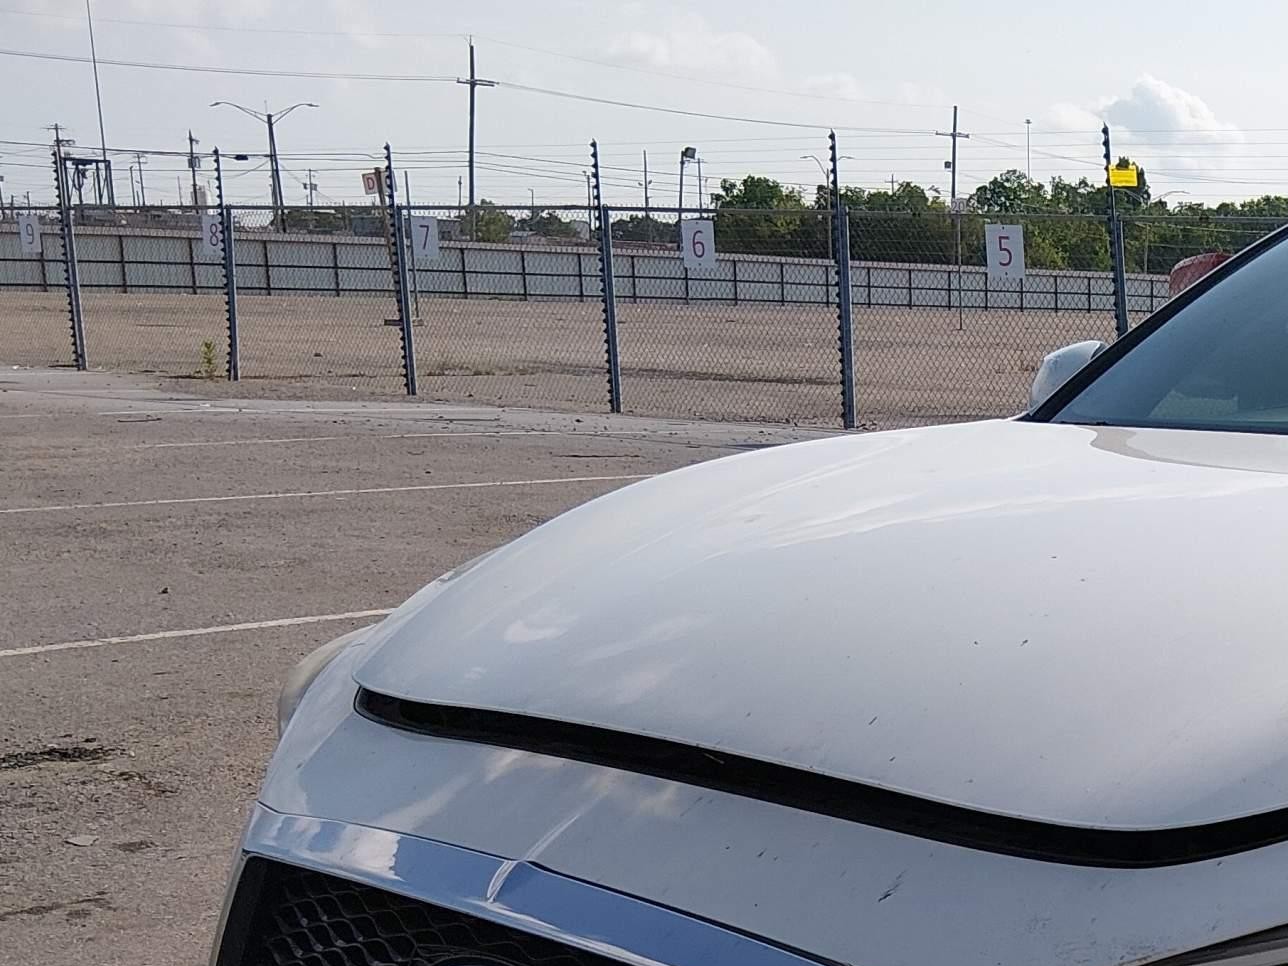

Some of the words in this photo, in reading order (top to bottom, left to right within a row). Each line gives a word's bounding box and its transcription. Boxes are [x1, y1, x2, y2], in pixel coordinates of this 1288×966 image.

[26, 223, 35, 245] 9
[209, 223, 219, 246] 8
[419, 224, 430, 250] 7
[691, 231, 706, 259] 6
[998, 235, 1013, 267] 5
